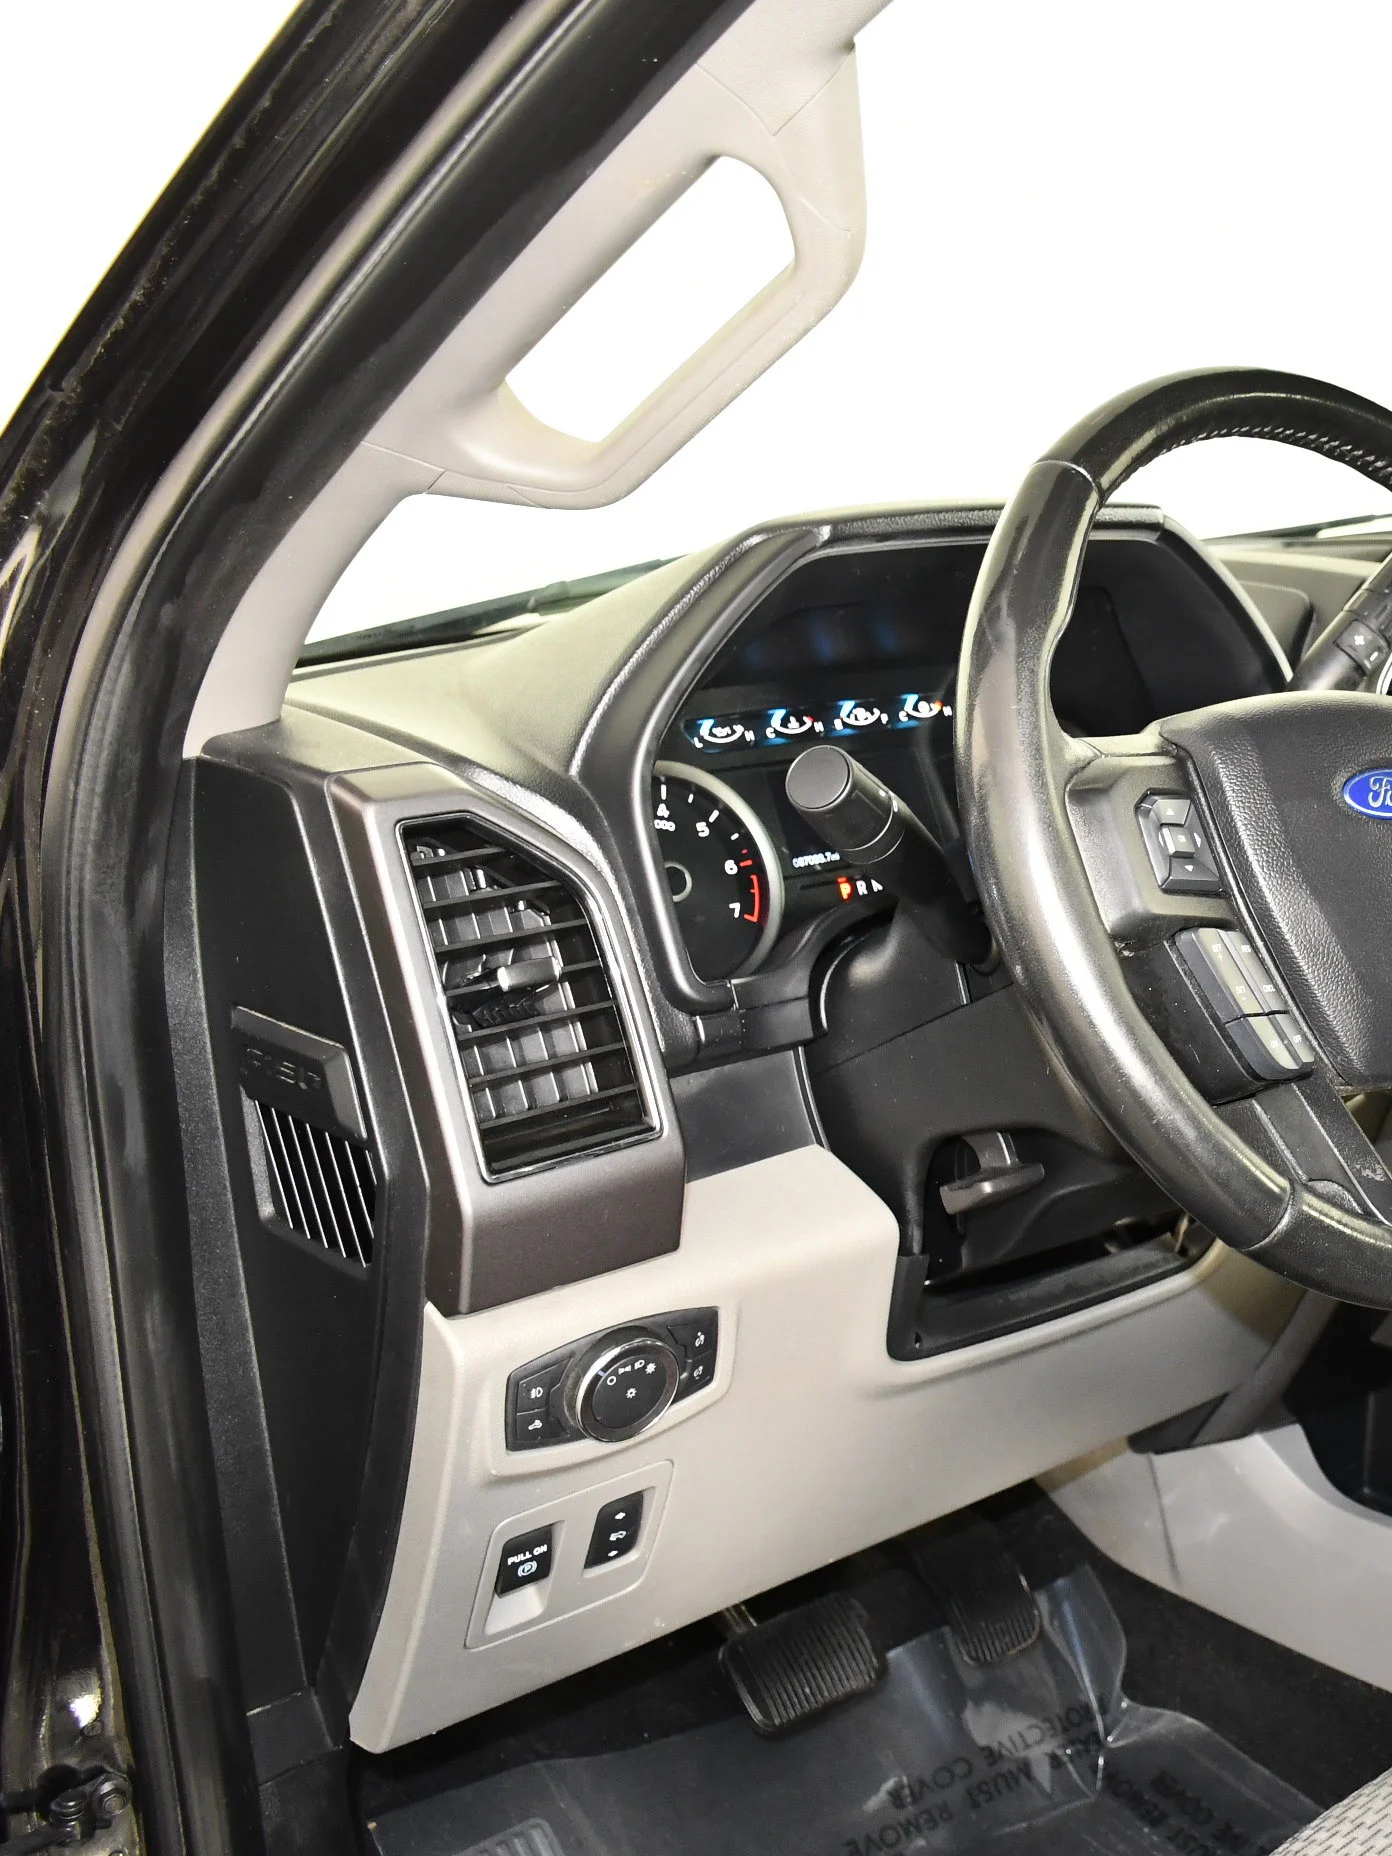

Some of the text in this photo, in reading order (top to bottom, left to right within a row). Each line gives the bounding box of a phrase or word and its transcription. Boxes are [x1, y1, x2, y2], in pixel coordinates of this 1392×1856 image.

[694, 737, 704, 749] L
[656, 803, 670, 818] 4
[695, 821, 710, 837] 5
[724, 859, 738, 875] 6
[839, 882, 851, 900] P
[856, 880, 868, 896] R
[728, 902, 741, 918] 7
[508, 1544, 547, 1565] PULL ON
